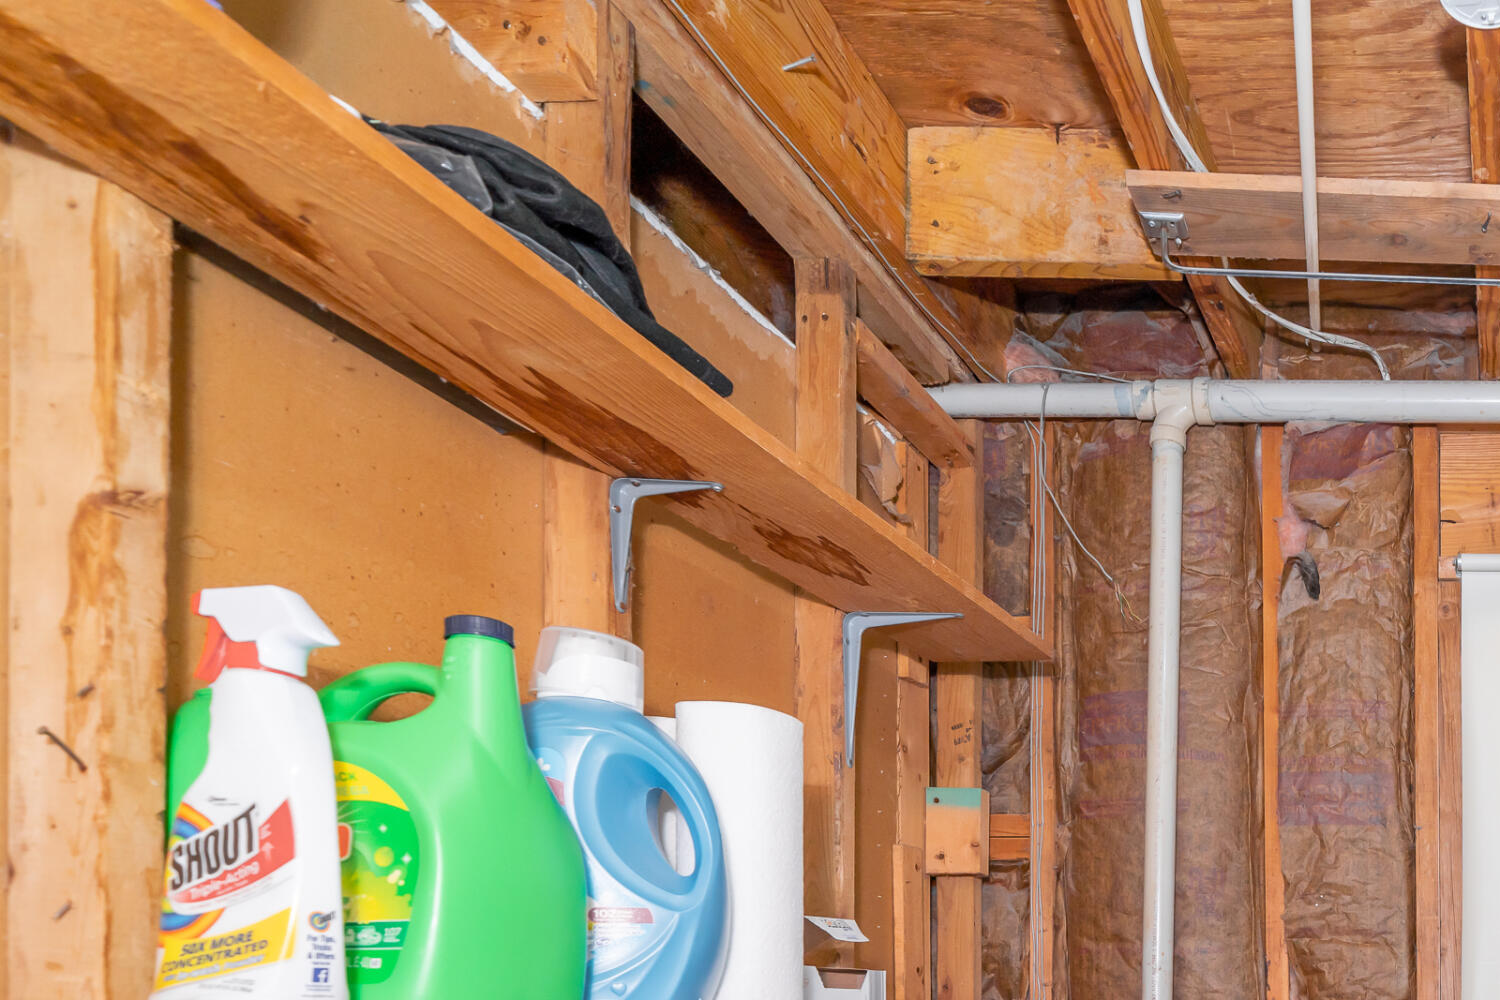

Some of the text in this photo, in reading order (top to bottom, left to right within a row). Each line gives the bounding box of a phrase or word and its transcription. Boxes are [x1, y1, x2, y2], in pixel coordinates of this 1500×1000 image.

[170, 803, 256, 891] SHOUT
[161, 939, 269, 974] CONCENTRATED
[210, 929, 254, 950] MORE
